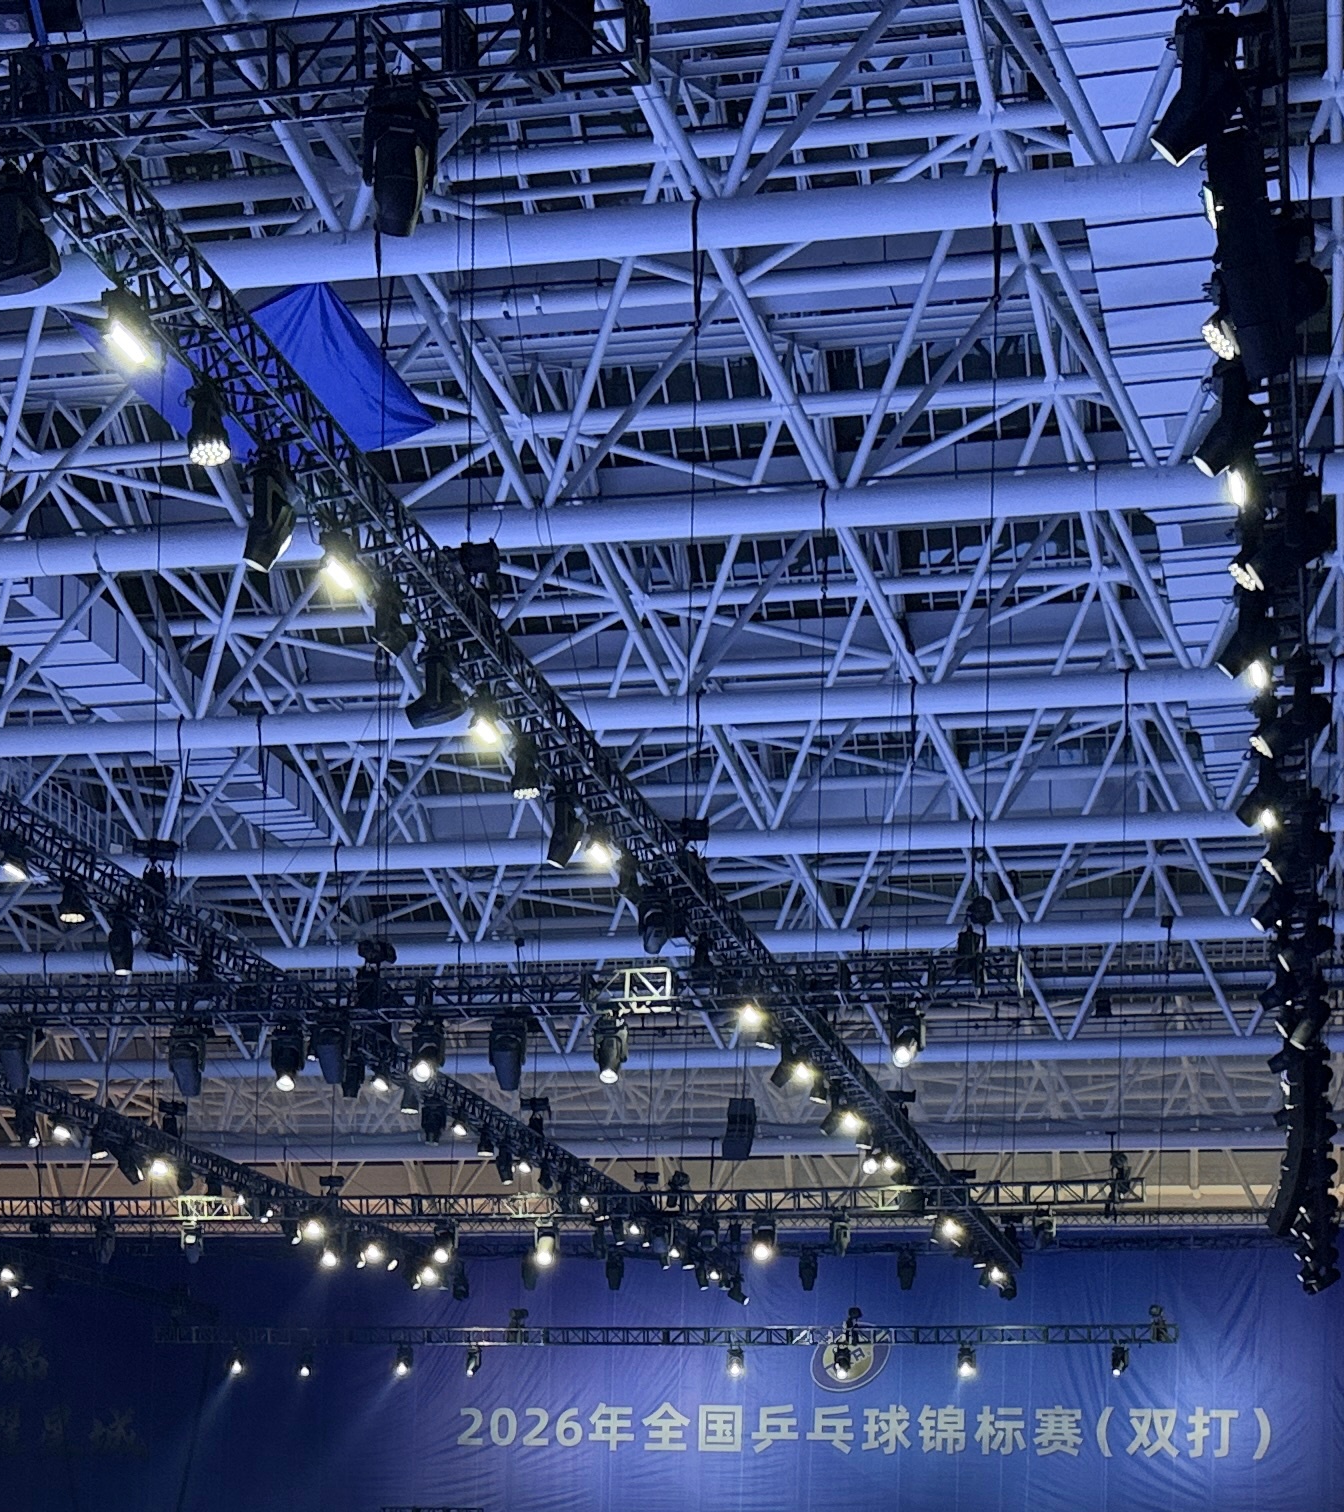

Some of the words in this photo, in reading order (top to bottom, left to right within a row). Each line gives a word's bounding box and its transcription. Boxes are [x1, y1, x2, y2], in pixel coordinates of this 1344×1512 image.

[457, 1403, 1272, 1459] 2026年全国乒乓球锦标赛(双打)
